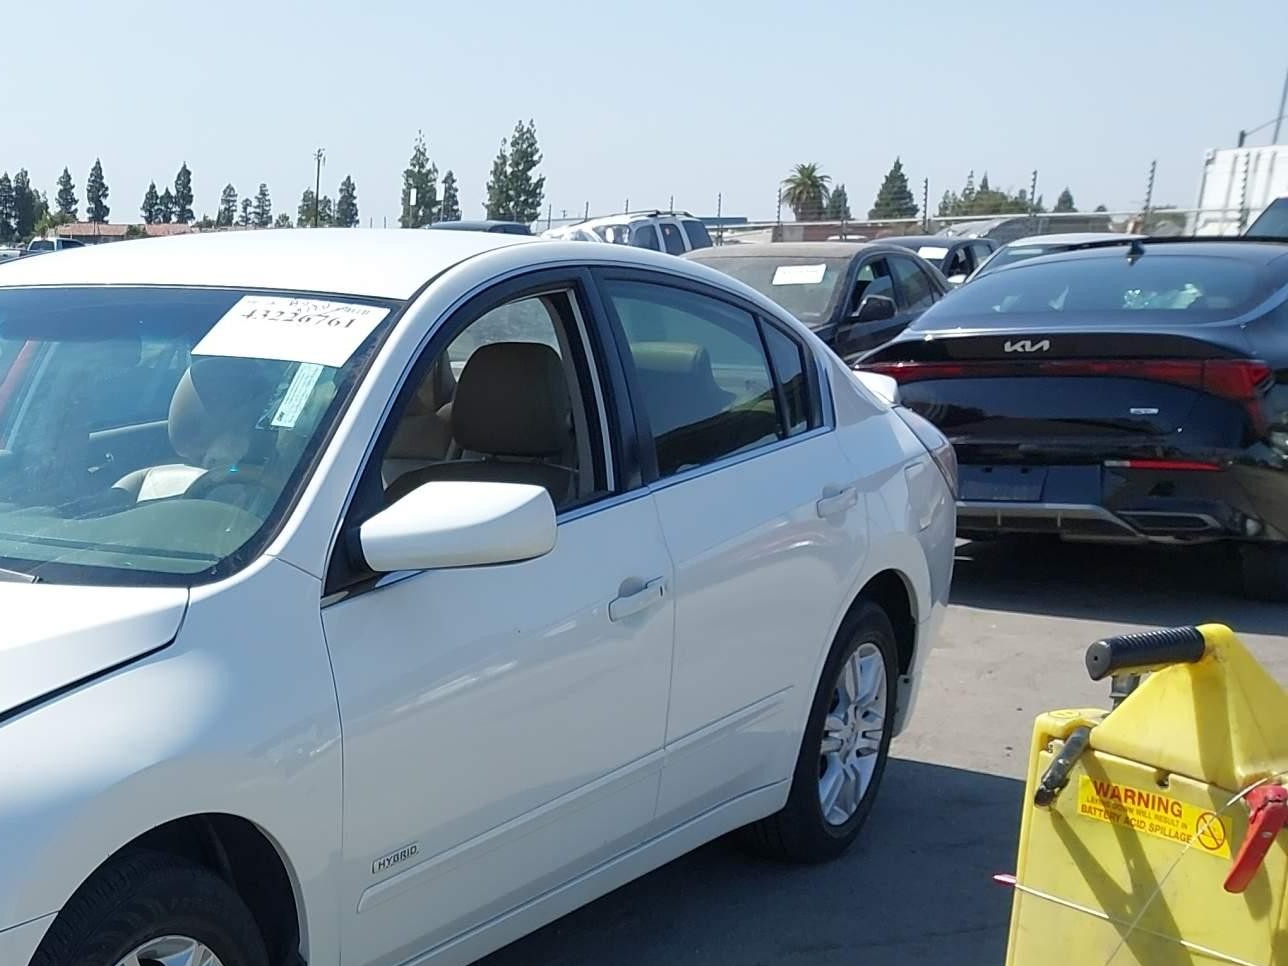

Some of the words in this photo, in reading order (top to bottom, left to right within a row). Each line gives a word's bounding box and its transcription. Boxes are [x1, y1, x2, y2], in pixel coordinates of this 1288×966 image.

[241, 308, 356, 328] 43226761
[1004, 340, 1050, 352] KIA
[1093, 780, 1183, 818] WARNING
[1081, 803, 1121, 822] BATTERY
[1125, 815, 1146, 830] ACID
[1148, 822, 1193, 844] SPILLAGE
[377, 844, 417, 870] HYBRID
